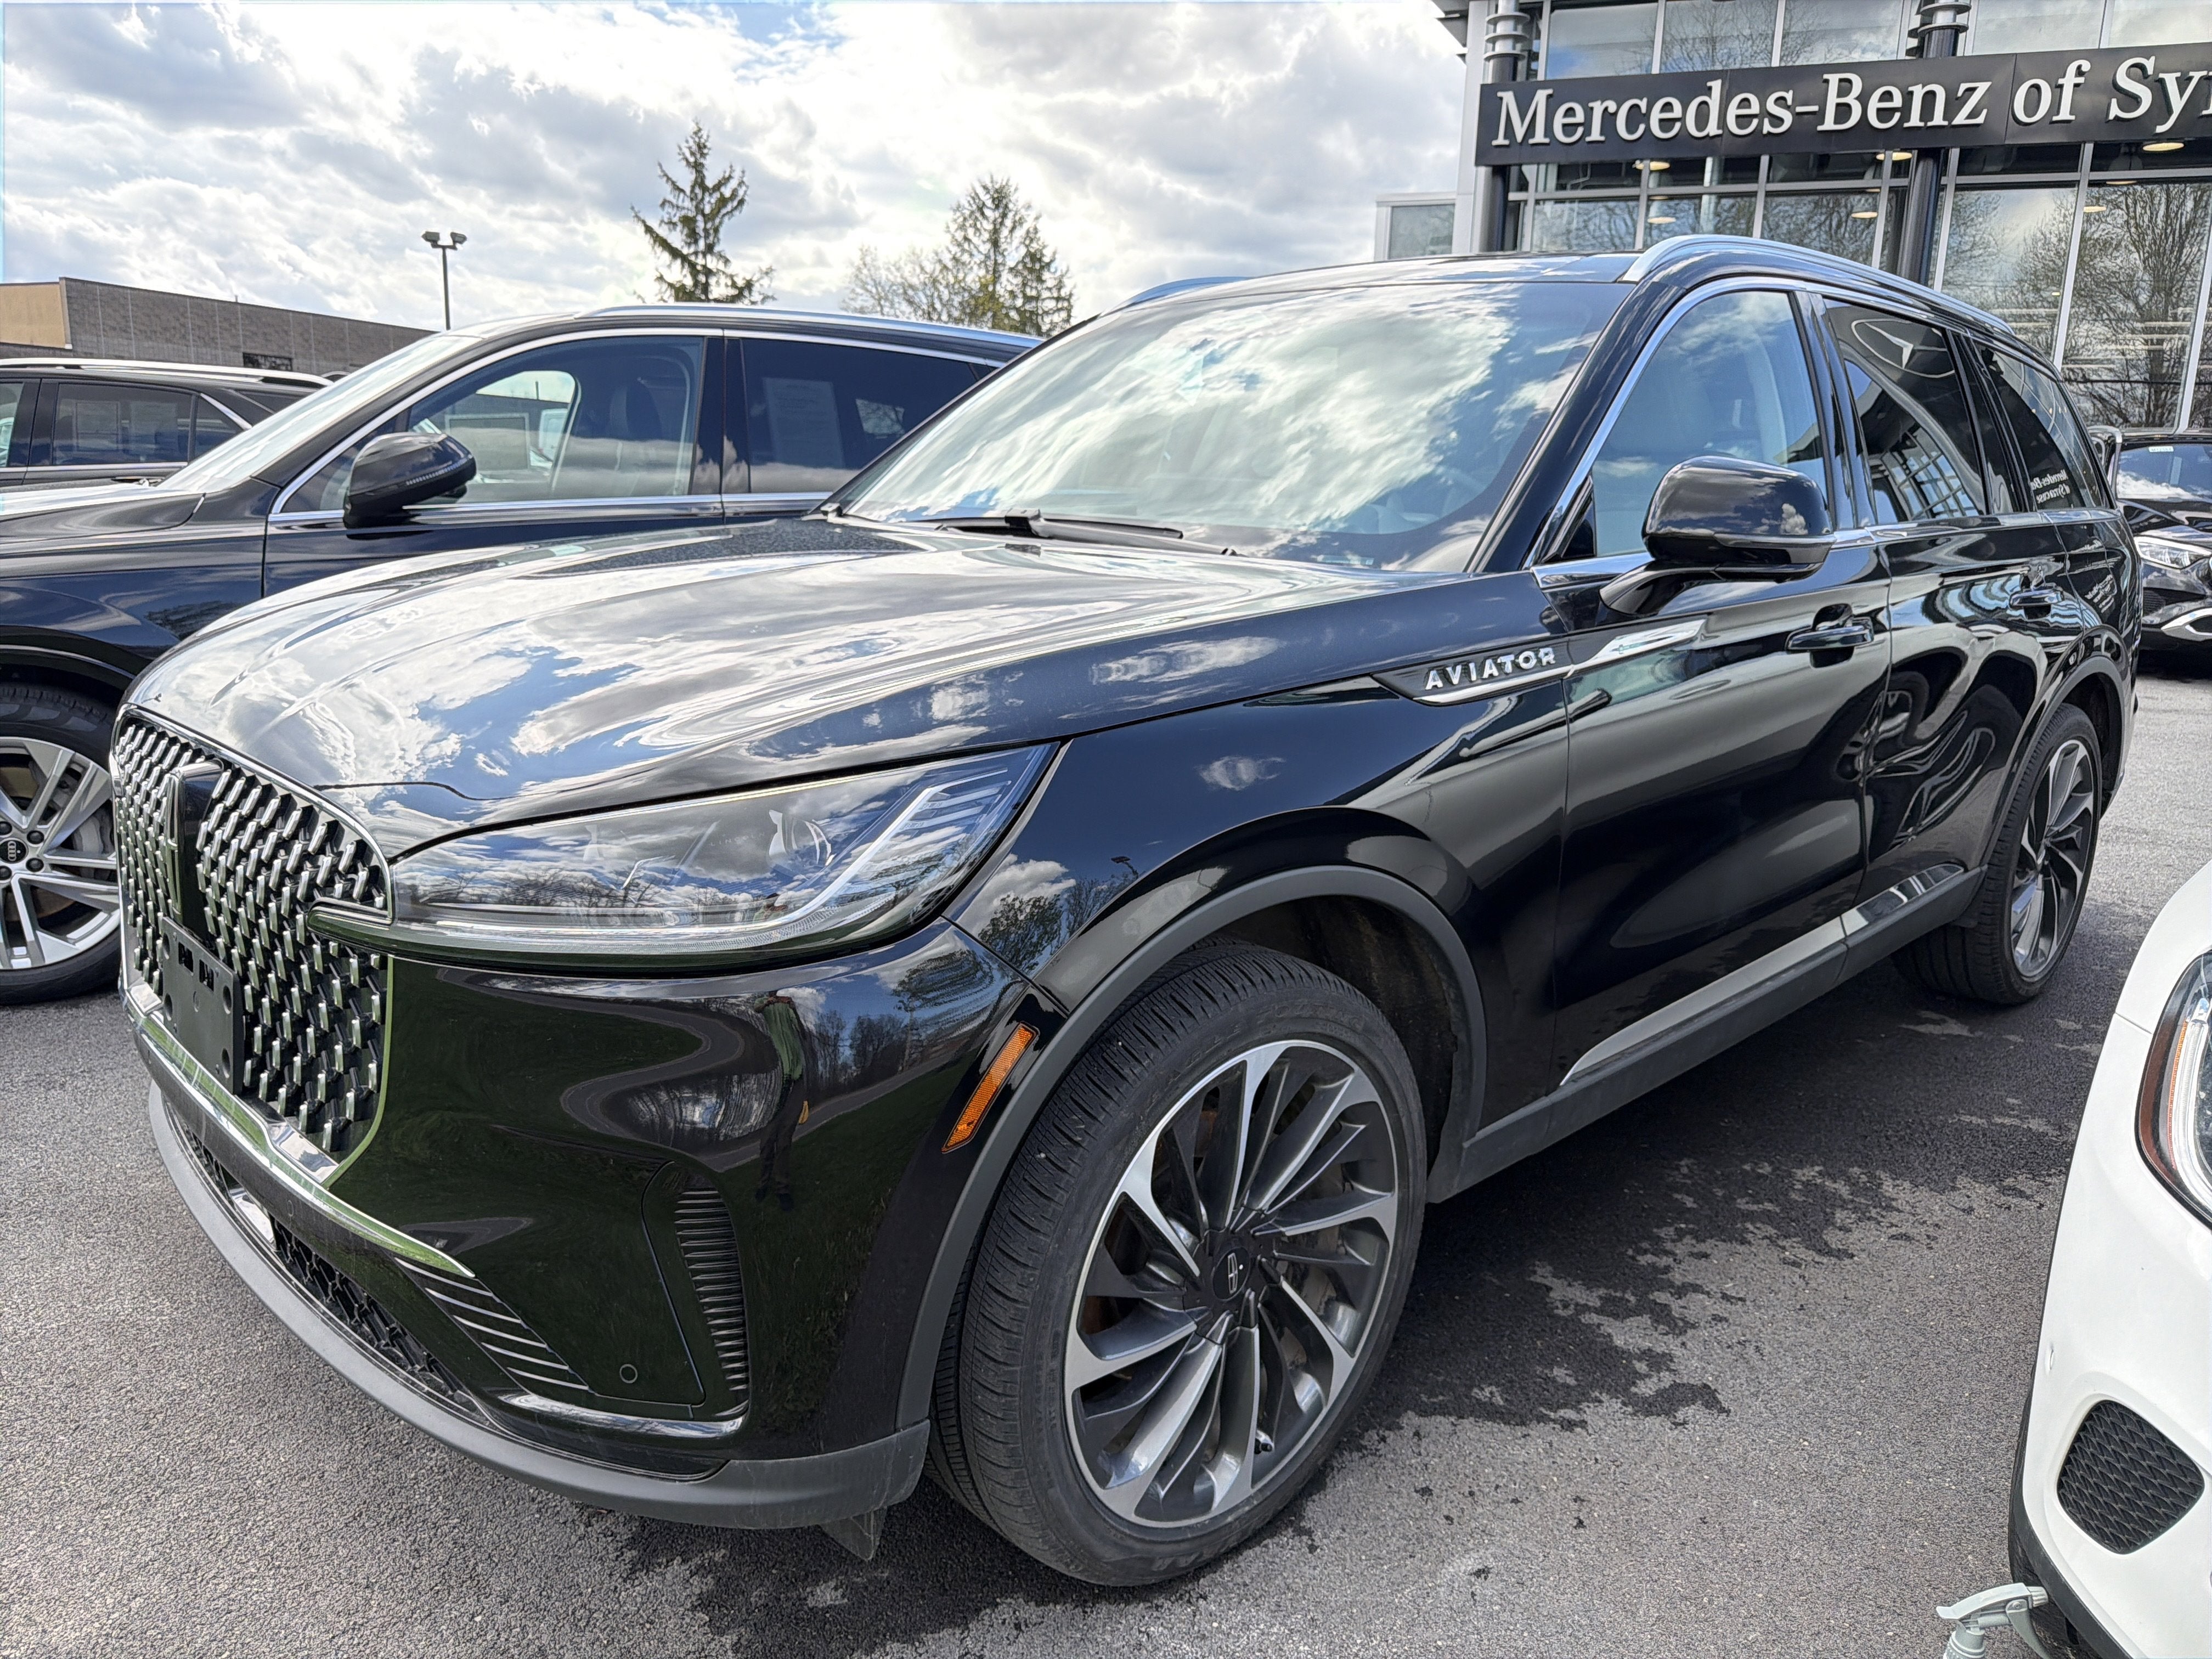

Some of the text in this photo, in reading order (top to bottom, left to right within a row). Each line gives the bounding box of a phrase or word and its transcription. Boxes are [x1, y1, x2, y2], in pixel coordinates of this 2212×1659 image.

[1491, 55, 2212, 146] Mercedes-Benz of Sy
[1425, 647, 1556, 690] AVIATOR
